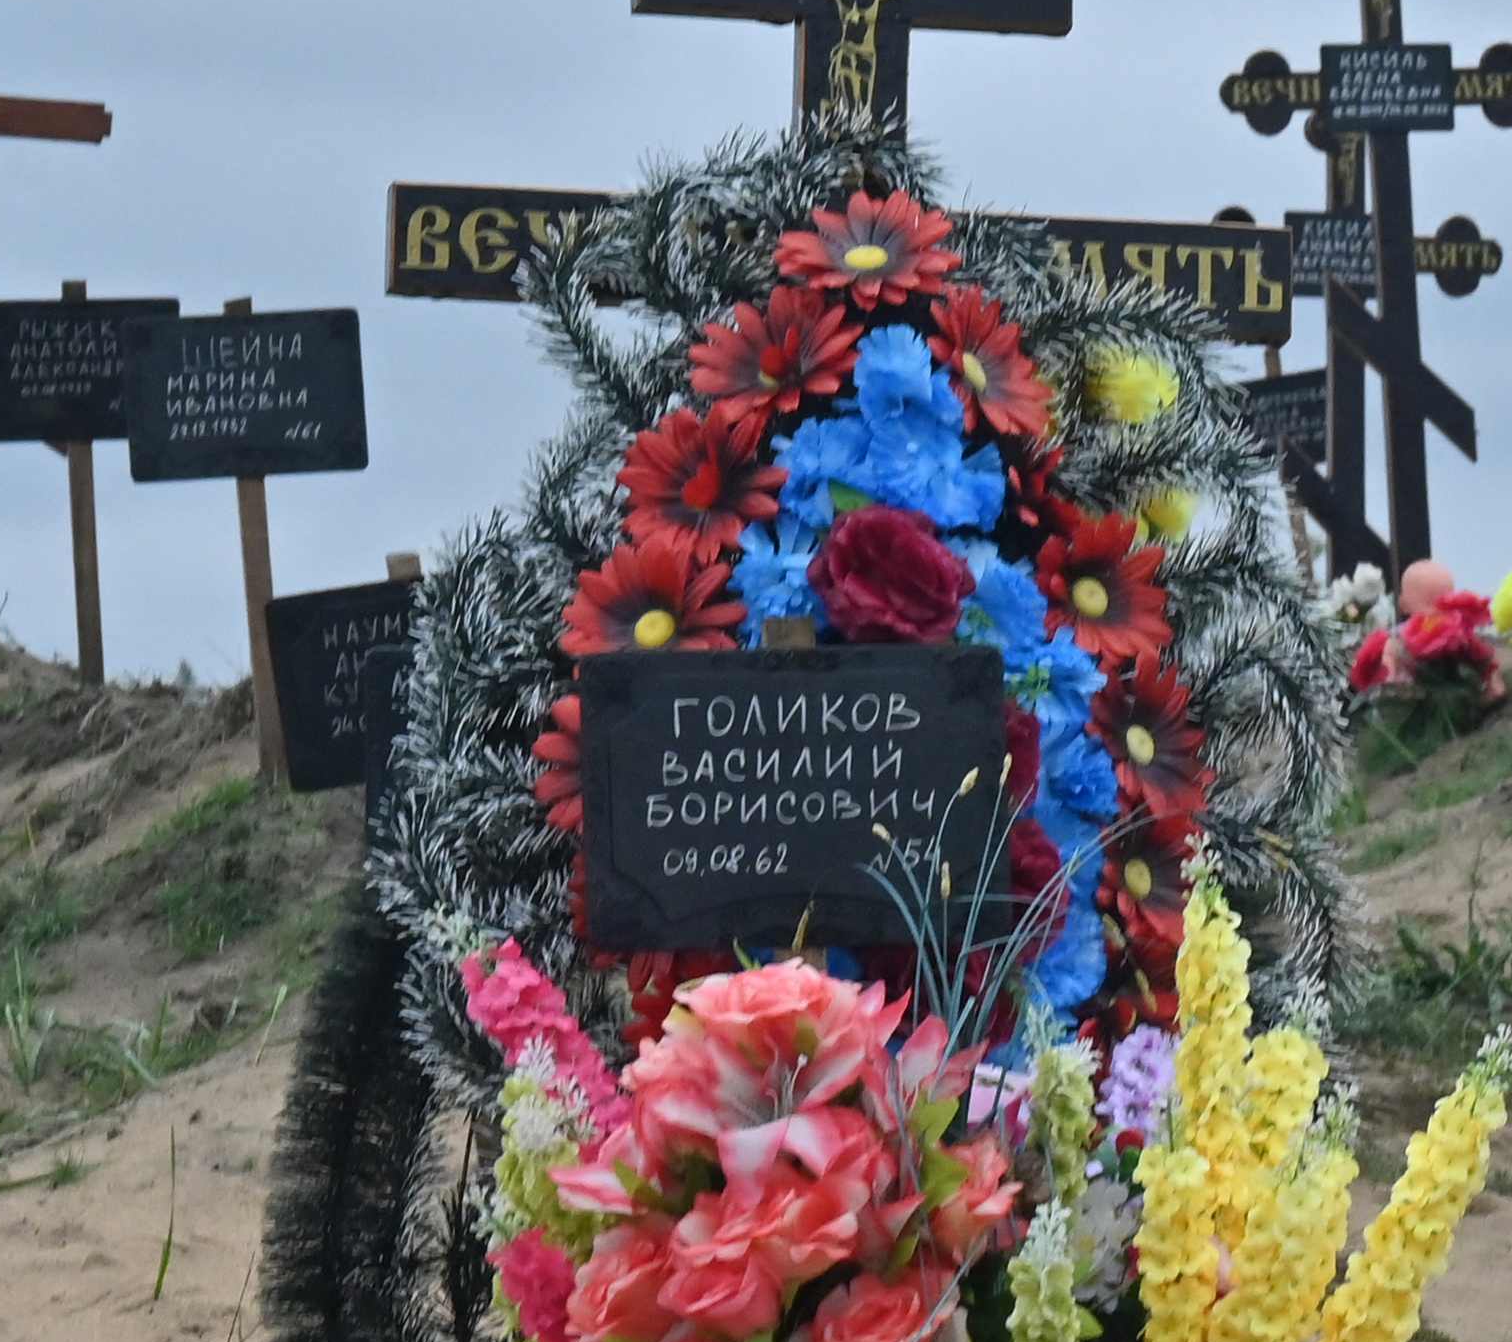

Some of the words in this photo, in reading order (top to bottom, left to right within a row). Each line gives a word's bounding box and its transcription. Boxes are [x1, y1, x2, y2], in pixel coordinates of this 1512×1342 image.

[1339, 49, 1428, 72] КИСИЛЬ
[1342, 70, 1401, 90] ЕЛЕНА
[18, 319, 117, 341] РЫЖИК
[182, 329, 303, 373] ШЕЙНА
[166, 367, 276, 395] МАРИНА
[165, 387, 308, 418] ИВАНОВНА
[672, 691, 922, 739] ГОЛИКОВ
[662, 741, 904, 787] ВАСИЛИЙ
[645, 788, 936, 829] БОРИСОВИЧ
